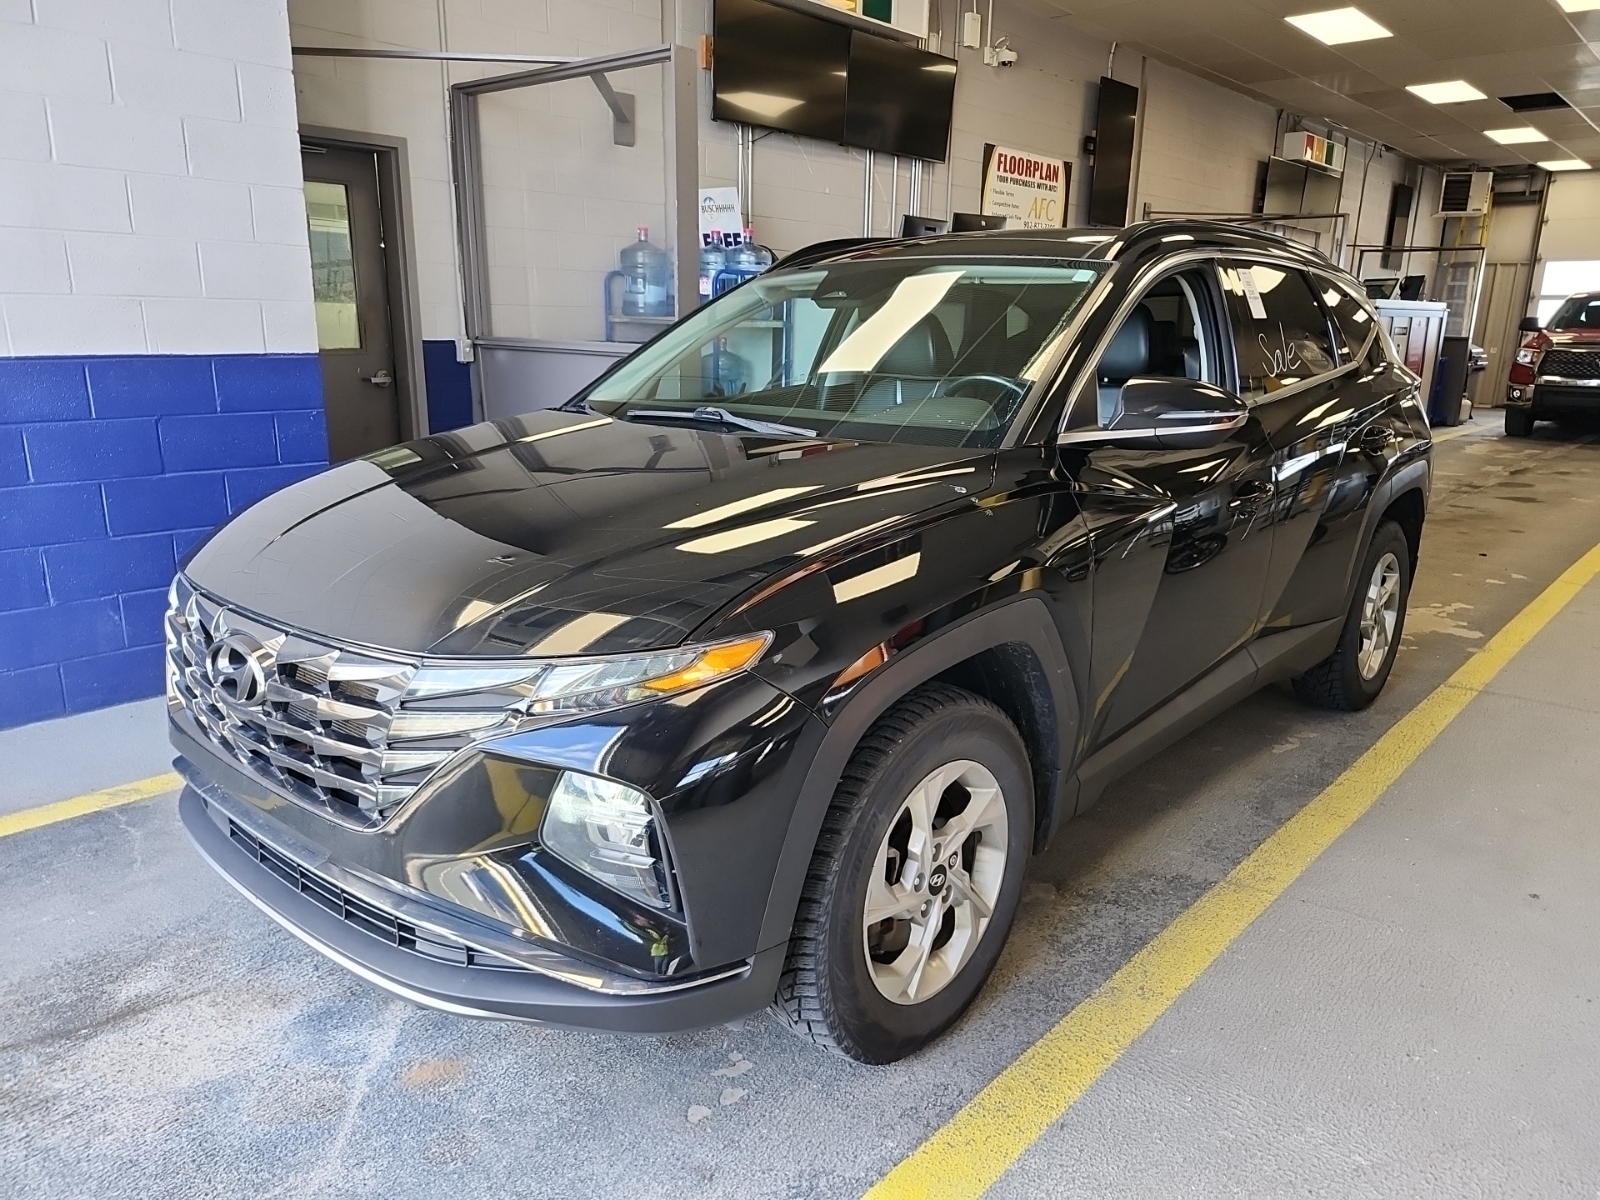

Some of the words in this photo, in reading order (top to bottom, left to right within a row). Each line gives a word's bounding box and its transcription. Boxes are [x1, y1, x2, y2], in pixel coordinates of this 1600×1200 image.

[997, 153, 1059, 183] FLOORPLAN
[997, 175, 1008, 184] YOUR
[1010, 177, 1035, 189] PURCHASES
[1037, 182, 1048, 191] WITH
[1028, 197, 1056, 221] AFC
[1258, 321, 1301, 377] Sale
